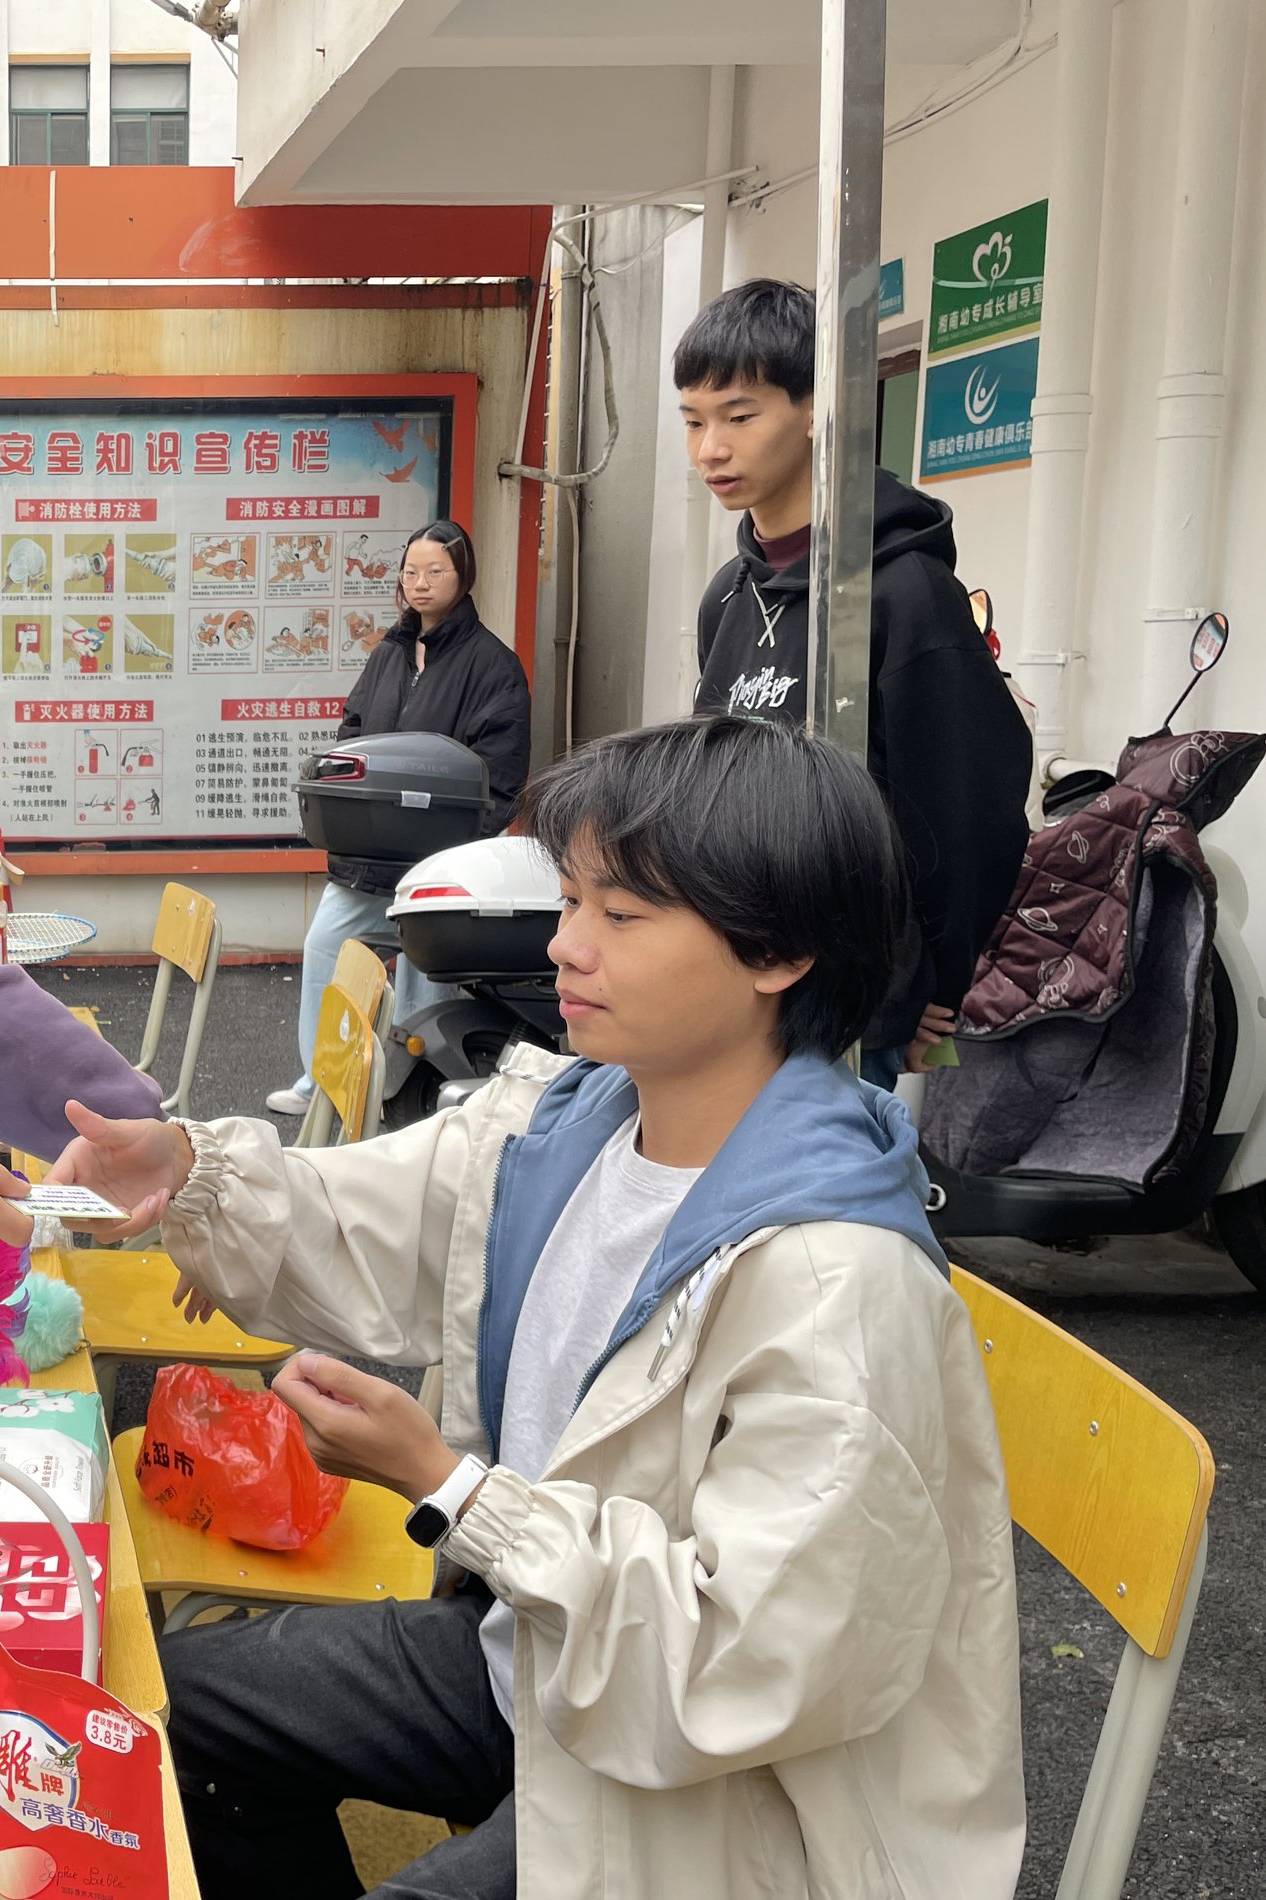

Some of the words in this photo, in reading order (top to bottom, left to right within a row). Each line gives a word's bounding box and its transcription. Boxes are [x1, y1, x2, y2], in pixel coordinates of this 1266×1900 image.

[39, 502, 141, 519] 消防栓使用方法
[240, 499, 367, 518] 消防安全漫画图解
[39, 703, 149, 720] 灭火器使用方法
[92, 1714, 128, 1735] 建议零售价
[90, 1725, 127, 1750] 3.8元
